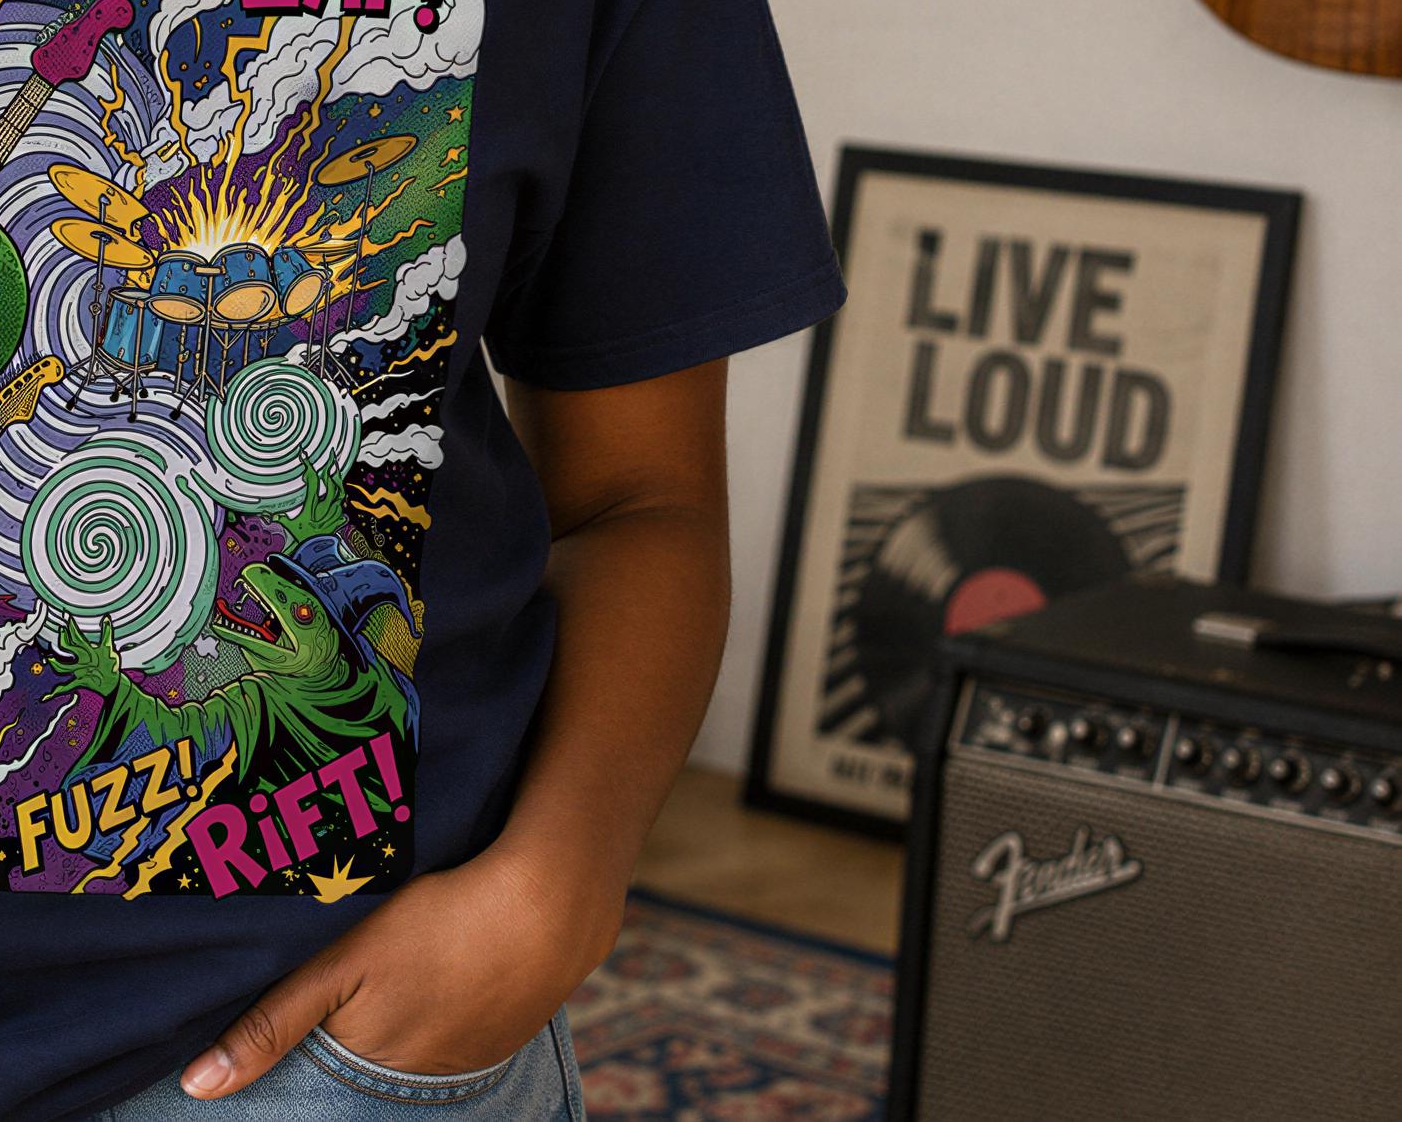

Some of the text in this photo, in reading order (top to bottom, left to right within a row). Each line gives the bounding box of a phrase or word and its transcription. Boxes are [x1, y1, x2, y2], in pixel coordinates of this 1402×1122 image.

[906, 225, 1135, 357] LIVE
[904, 339, 1171, 474] LOUD
[15, 738, 200, 873] FUZZ!
